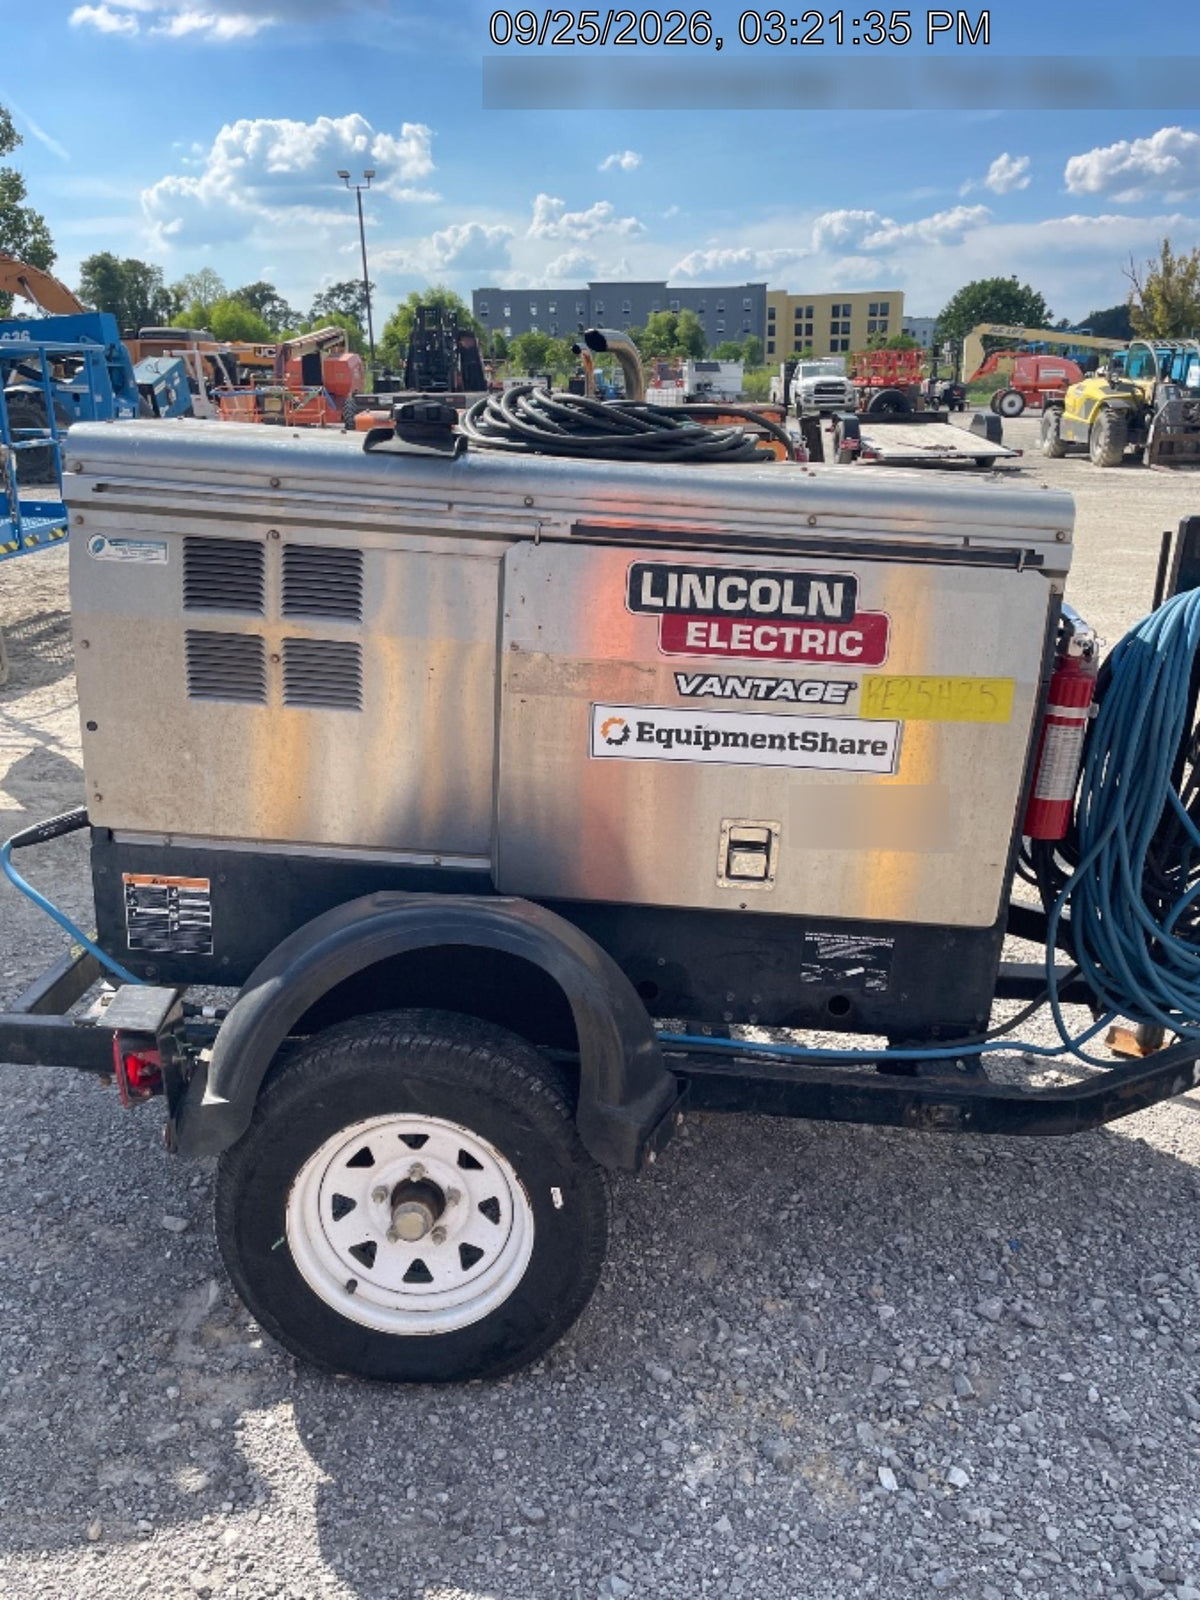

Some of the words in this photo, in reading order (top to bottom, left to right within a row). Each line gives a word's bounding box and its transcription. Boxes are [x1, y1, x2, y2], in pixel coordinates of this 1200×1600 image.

[641, 571, 844, 618] LINCOLN
[686, 621, 864, 657] ELECTRIC
[674, 672, 853, 705] VANTAGE
[636, 721, 889, 757] EquipmentShare
